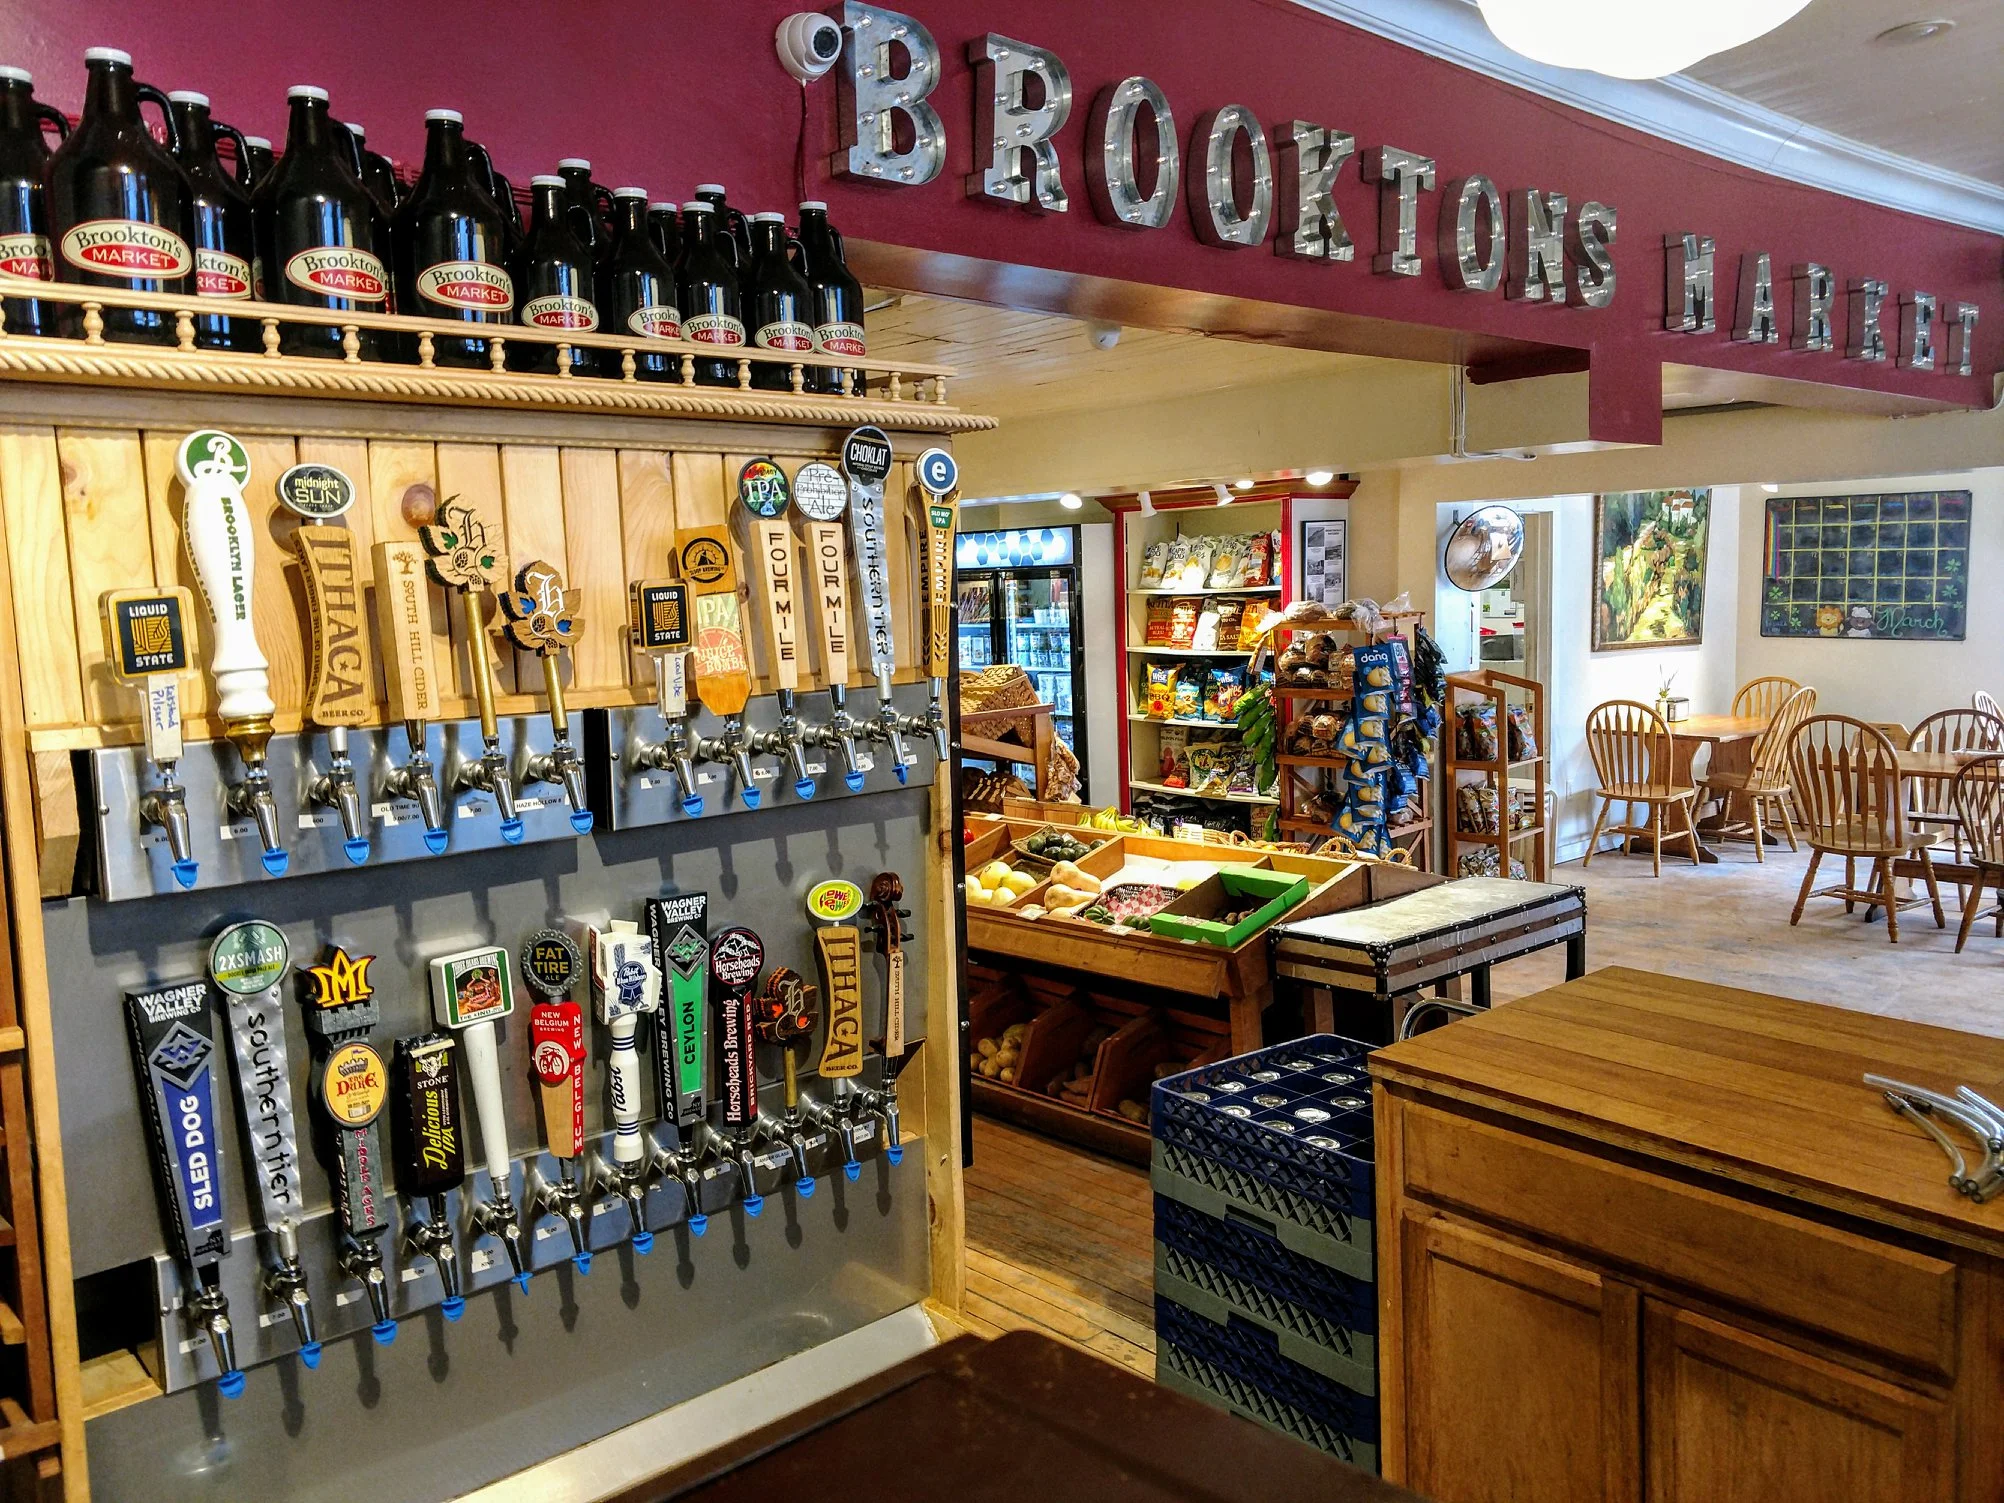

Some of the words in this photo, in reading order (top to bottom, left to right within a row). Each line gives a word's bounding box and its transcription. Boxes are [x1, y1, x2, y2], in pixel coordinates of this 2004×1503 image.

[833, 1, 1617, 309] BROOKTONS
[1664, 231, 1980, 376] MARKET
[75, 226, 182, 259] Brookton's
[92, 248, 171, 269] MARKET
[319, 271, 380, 292] MARKET
[430, 266, 511, 294] Brookton's
[446, 286, 505, 303] MARKET
[529, 298, 594, 319] Brookton's
[540, 314, 587, 327] MARKET
[697, 331, 739, 343] MARKET
[773, 338, 811, 350] MARKET
[850, 442, 888, 466] CHOKLAT
[294, 476, 339, 490] midnight
[809, 468, 840, 484] Pre-
[931, 461, 947, 482] e
[295, 487, 341, 504] SUN
[746, 479, 787, 503] IPA
[809, 495, 836, 516] Ale
[221, 496, 242, 572] BROOKLYN
[232, 576, 246, 621] LAGER
[768, 532, 789, 593] FOUR
[819, 529, 840, 589] FOUR
[919, 529, 930, 603] EMPIRE
[935, 529, 947, 603] EMPIRE
[305, 574, 318, 613] FINGER
[403, 579, 419, 625] SOUTH
[651, 591, 678, 601] LIQUID
[128, 603, 168, 618] LIQUID
[306, 535, 364, 706] ITHACA
[1876, 606, 1948, 638] March
[654, 630, 681, 641] STATE
[776, 600, 795, 661] MILE
[825, 595, 844, 654] MILE
[314, 639, 321, 650] OF
[408, 630, 425, 665] HILL
[136, 652, 174, 668] STATE
[311, 654, 321, 687] SPIRIT
[412, 666, 429, 711] CIDER
[1152, 673, 1168, 681] WISE
[1149, 693, 1171, 702] BBQ
[322, 709, 349, 718] BEER
[350, 709, 366, 717] CO.
[380, 804, 395, 813] OLD
[516, 801, 533, 809] HAZE
[533, 799, 557, 807] HOLLOW
[661, 896, 706, 911] WAGNER
[664, 904, 703, 918] VALLEY
[666, 915, 694, 924] BREWING
[218, 945, 283, 972] 2XSMASH
[535, 947, 565, 960] FAT
[533, 961, 569, 974] TIRE
[715, 957, 761, 975] Horseheads
[721, 967, 755, 980] Brewing
[137, 983, 207, 1009] WAGNER
[143, 994, 203, 1018] VALLEY
[649, 902, 661, 971] WAGNER
[660, 1030, 674, 1098] BREWING
[821, 933, 859, 1063] ITHACA
[148, 1008, 190, 1024] BREWING
[534, 1019, 569, 1027] BELGIUM
[541, 1011, 561, 1019] NEW
[722, 998, 741, 1051] Brewing
[573, 1013, 582, 1050] NEW
[682, 1000, 695, 1066] CEYLON
[745, 1034, 756, 1106] BRICKYARD
[417, 1075, 449, 1090] STONE
[724, 1051, 742, 1123] Horseheads
[180, 1094, 205, 1149] DOG
[573, 1064, 584, 1155] BELGIUM
[421, 1089, 448, 1170] Delicious
[441, 1125, 456, 1155] IPA
[187, 1151, 213, 1211] SLED
[361, 1184, 375, 1227] AGES
